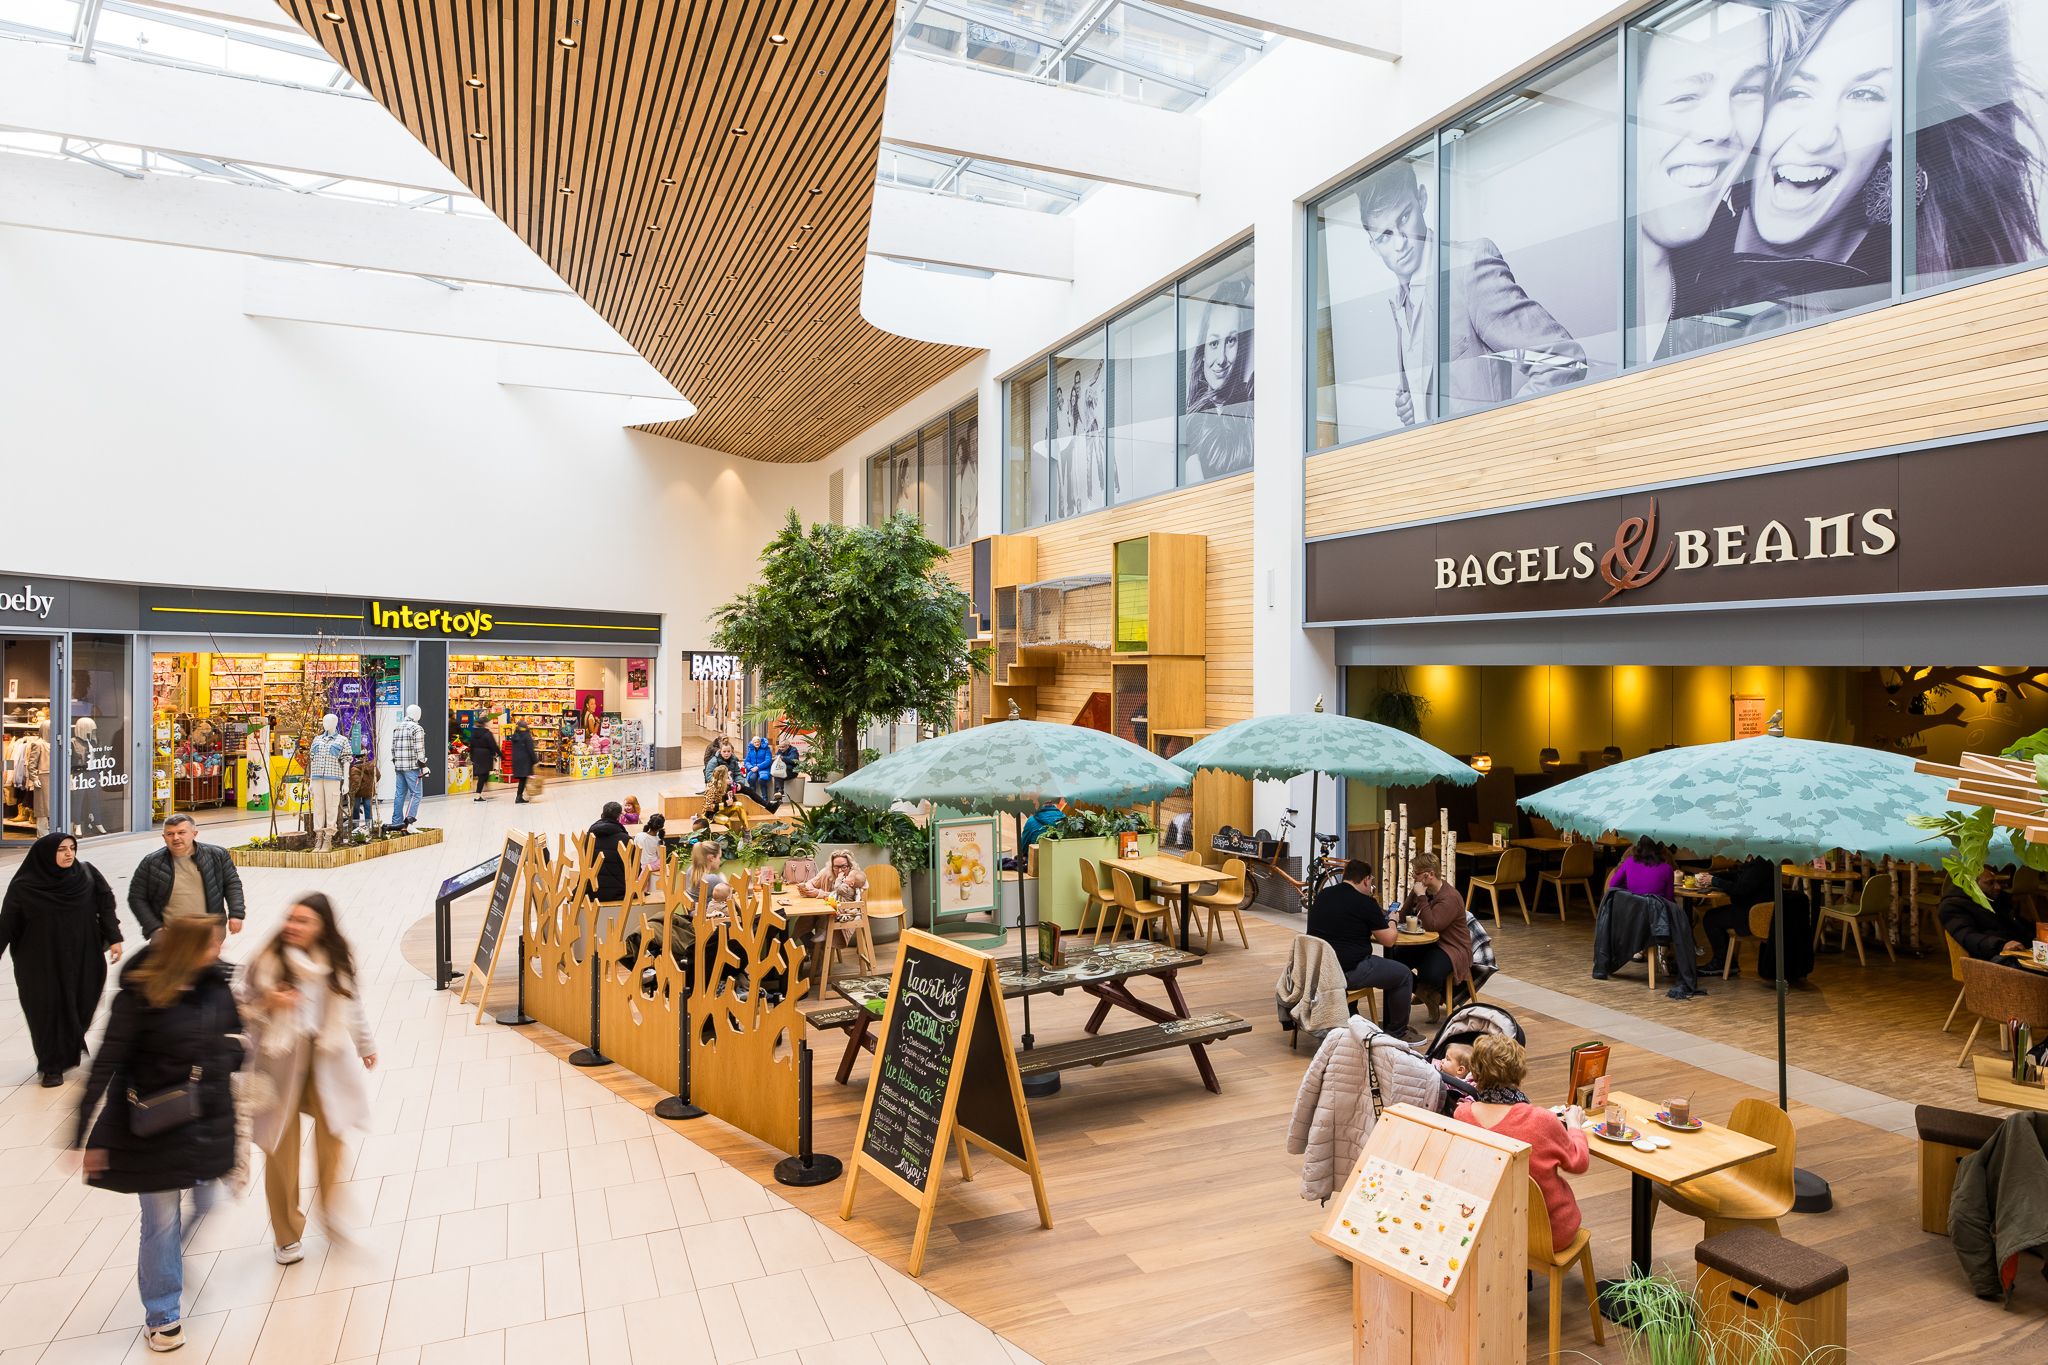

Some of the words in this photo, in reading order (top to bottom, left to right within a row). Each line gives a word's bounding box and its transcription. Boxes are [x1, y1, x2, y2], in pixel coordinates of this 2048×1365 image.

[1434, 541, 1597, 590] BAGELS
[1674, 508, 1899, 572] BEANS
[0, 585, 55, 619] oeby
[372, 601, 493, 637] Intertoys
[86, 754, 116, 771] into
[72, 772, 97, 791] the
[99, 769, 129, 788] blue
[895, 1157, 923, 1186] enjoy
